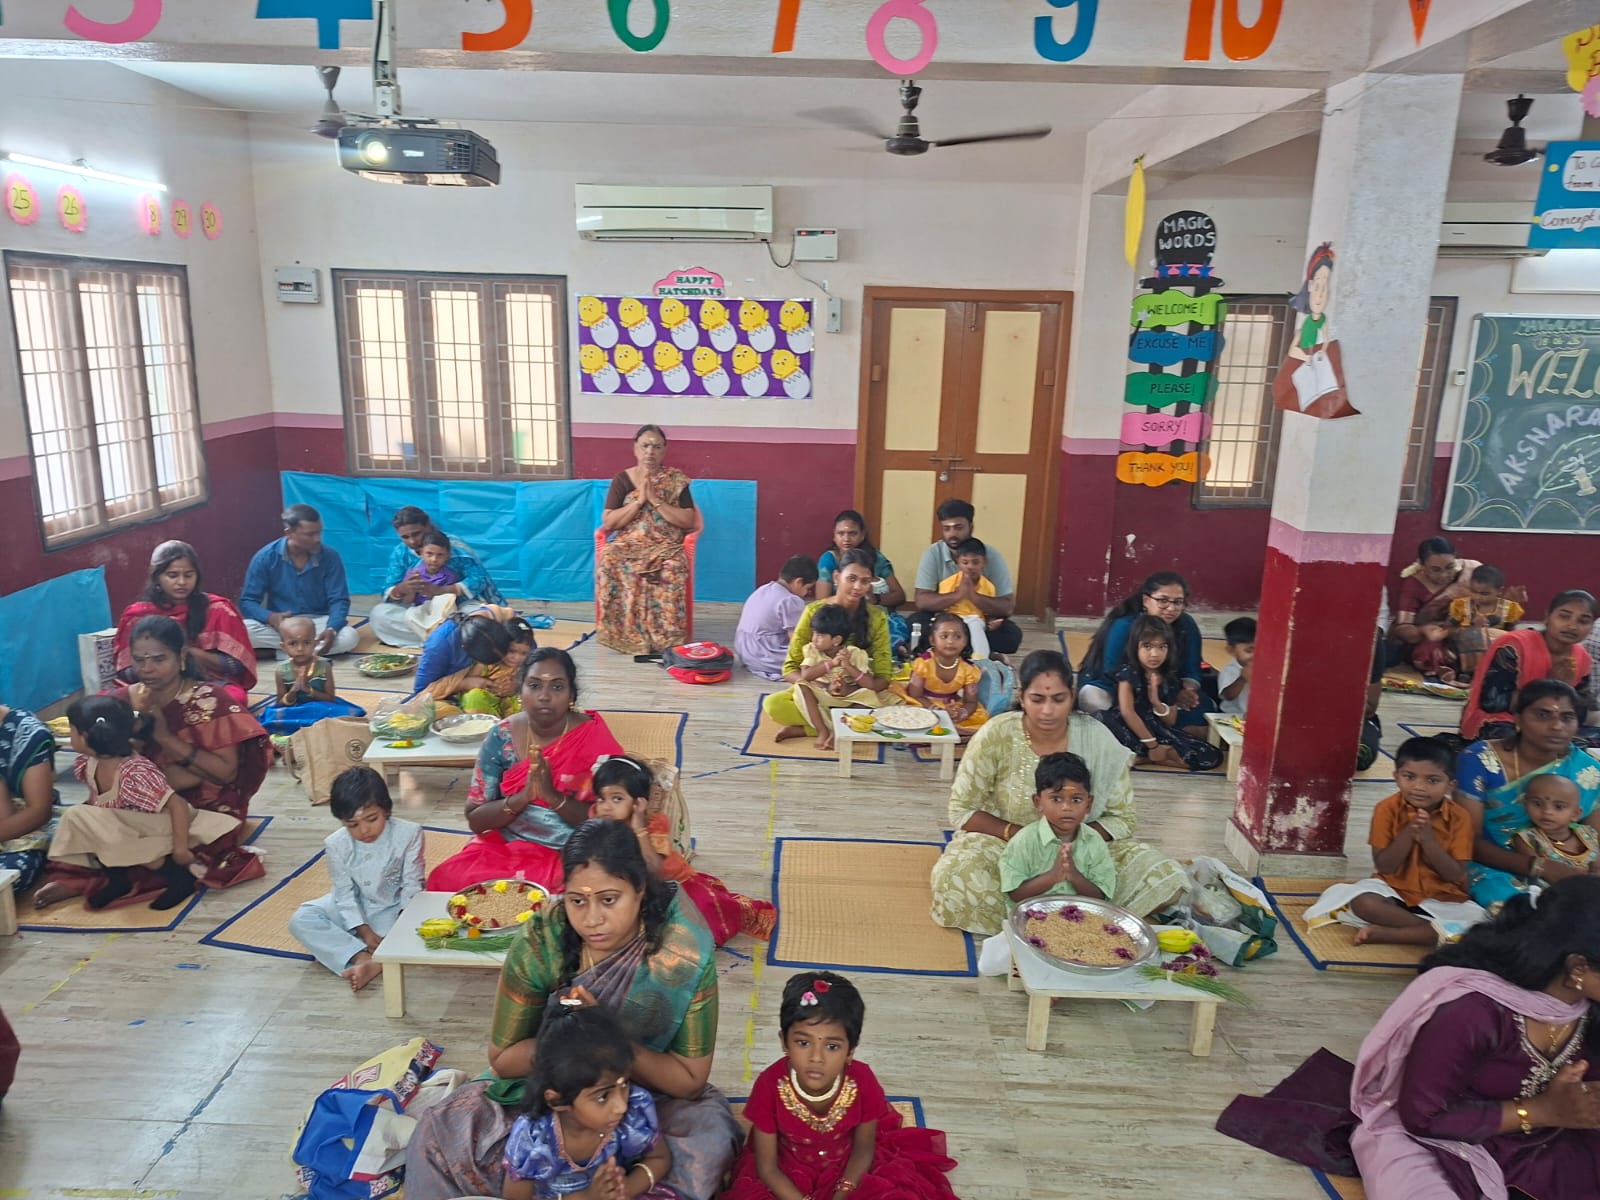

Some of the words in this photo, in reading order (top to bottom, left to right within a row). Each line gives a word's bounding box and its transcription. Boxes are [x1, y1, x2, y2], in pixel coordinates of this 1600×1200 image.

[63, 195, 80, 216] 26
[1163, 216, 1213, 234] MAGIC
[1158, 232, 1216, 250] WORDS
[675, 276, 713, 285] HAPPY
[658, 287, 722, 296] HATCHDAYS
[1146, 302, 1205, 317] WELCOME!
[1136, 338, 1180, 350] EXCUSE
[1150, 382, 1196, 396] PLEASE!
[1141, 420, 1188, 435] SORRY!
[1128, 461, 1165, 474] THANK
[1170, 461, 1194, 475] YOU!
